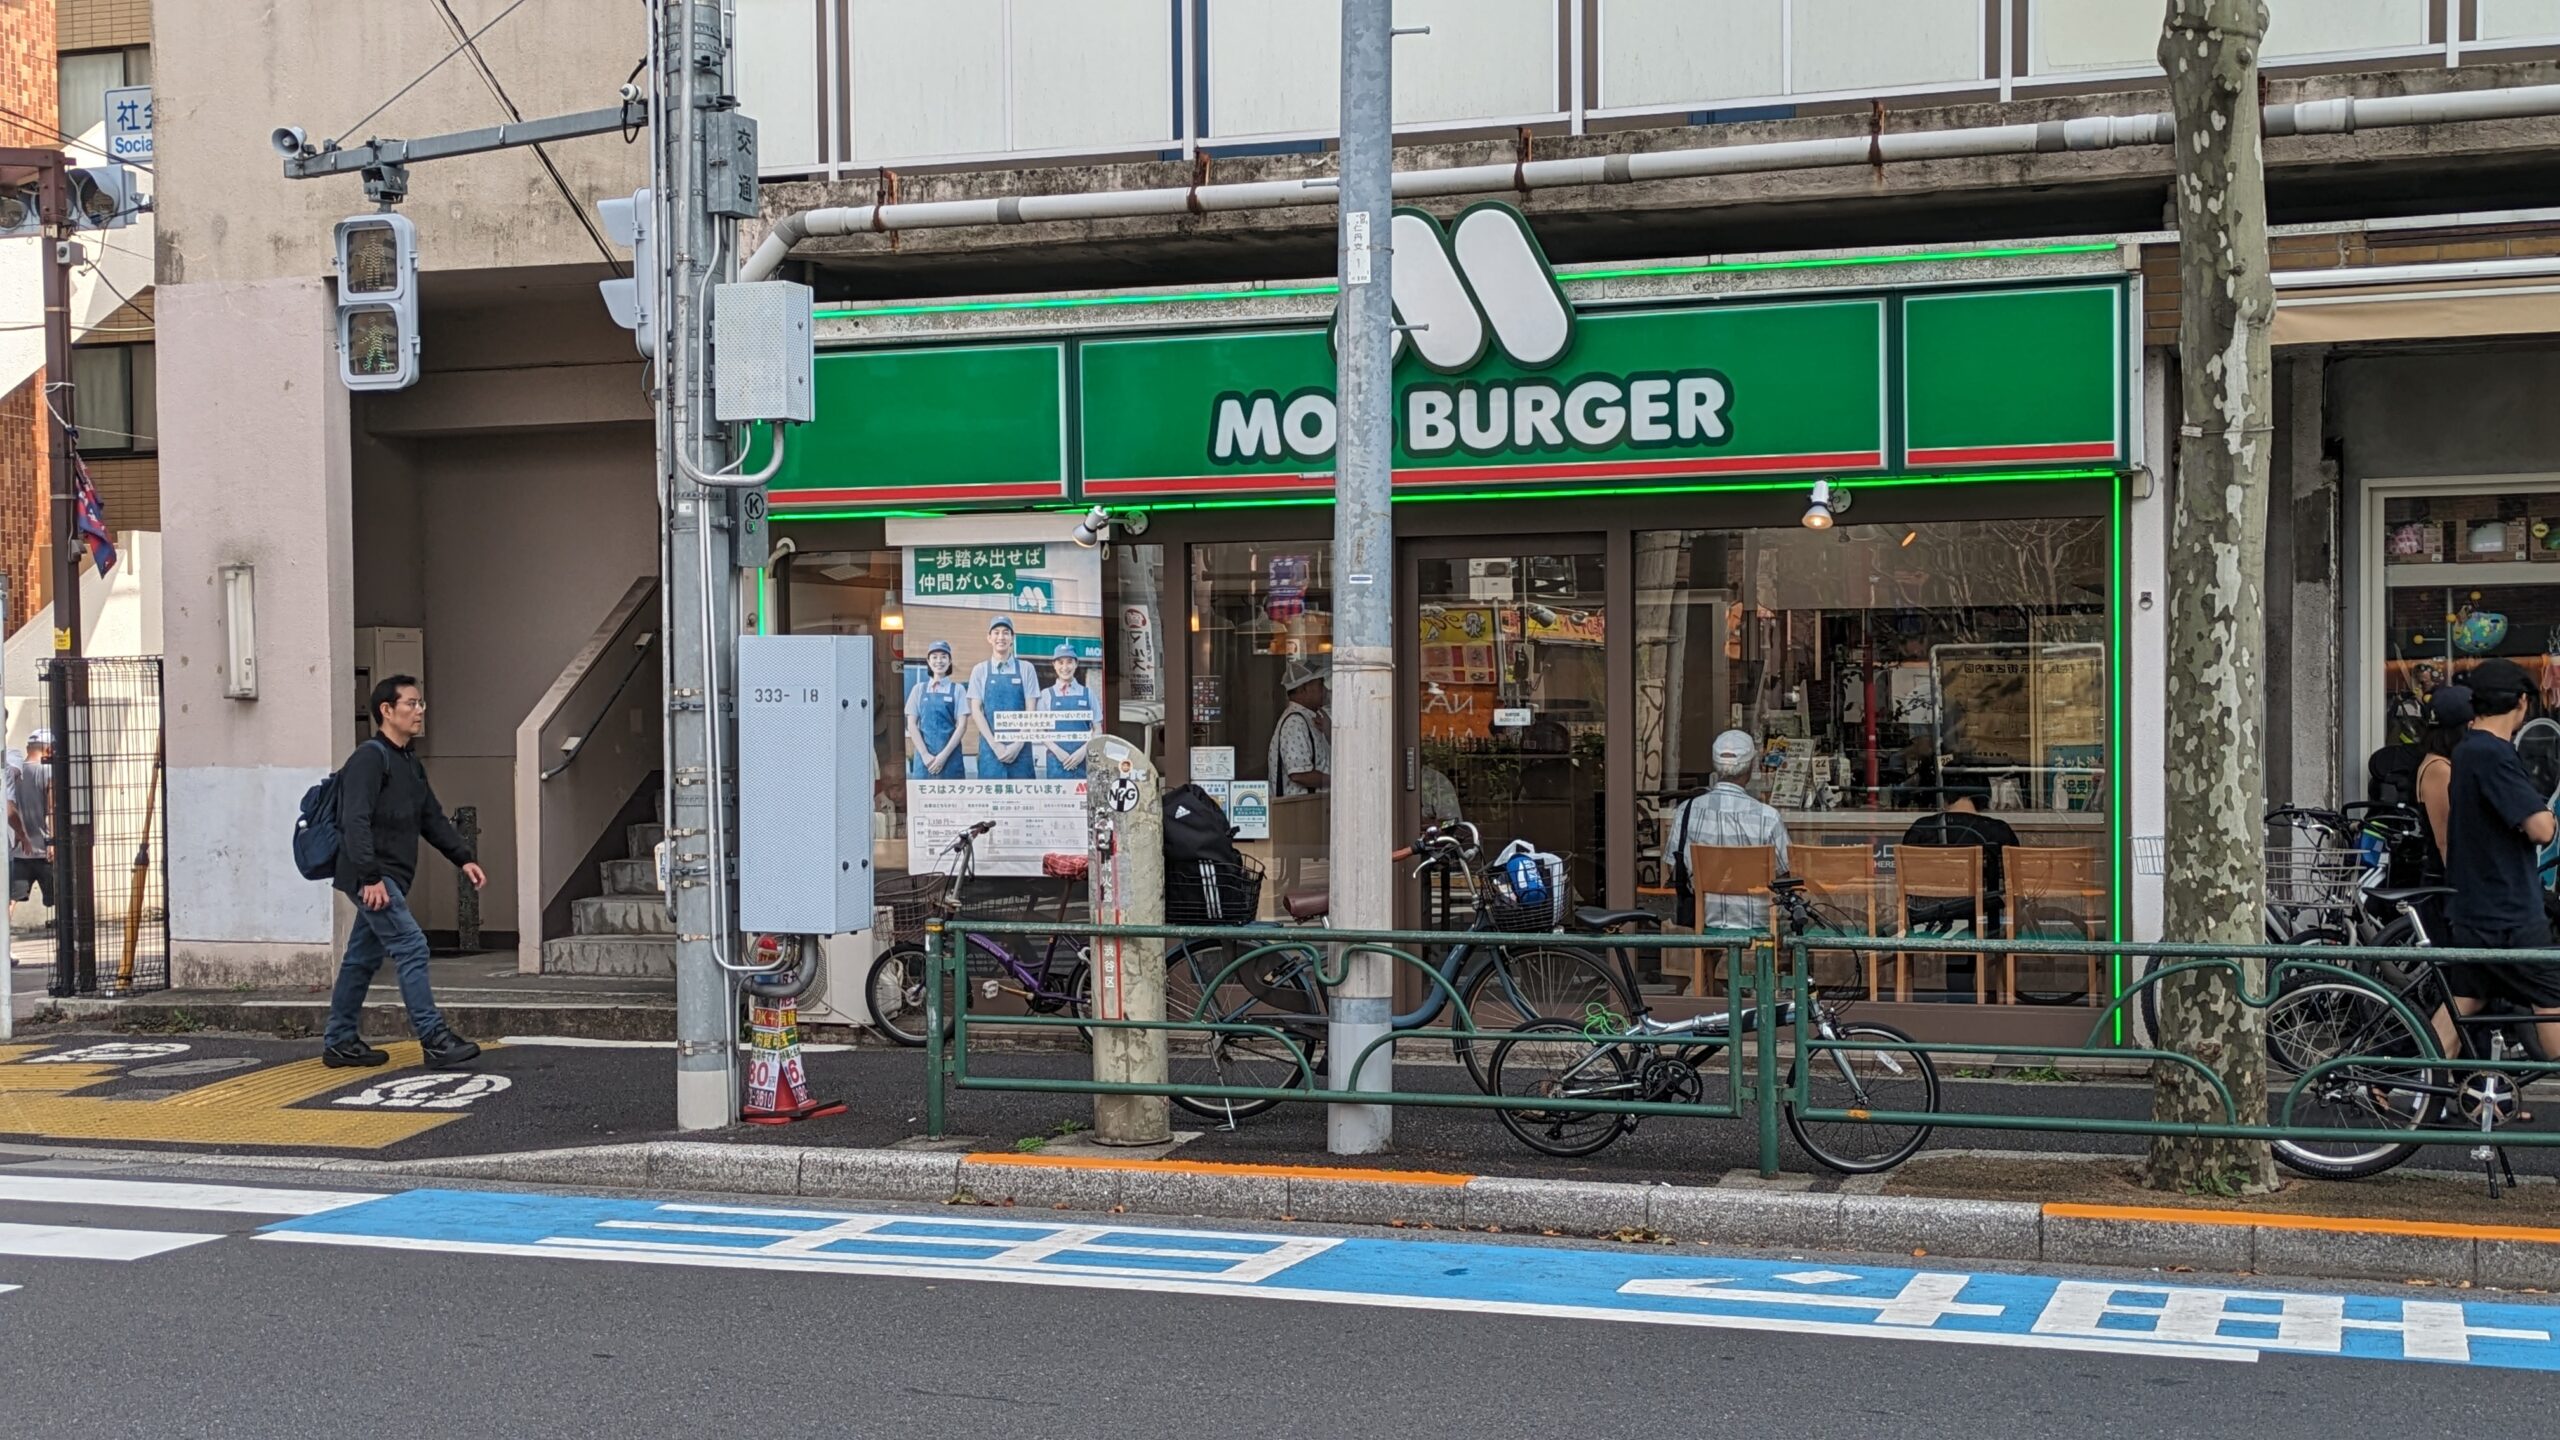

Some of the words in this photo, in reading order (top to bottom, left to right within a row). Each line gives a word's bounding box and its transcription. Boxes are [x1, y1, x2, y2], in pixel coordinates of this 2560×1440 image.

[737, 127, 752, 203] 交通
[1214, 396, 1337, 459] MO
[1408, 376, 1727, 451] BURGER
[917, 548, 1042, 569] 一歩踏み出せば
[918, 572, 1014, 593] 仲間がいる。
[802, 688, 819, 703] 18
[917, 783, 1067, 796] モスはスタッフを募集しています。
[1873, 860, 1896, 868] HERE
[1103, 945, 1115, 989] 渋谷区
